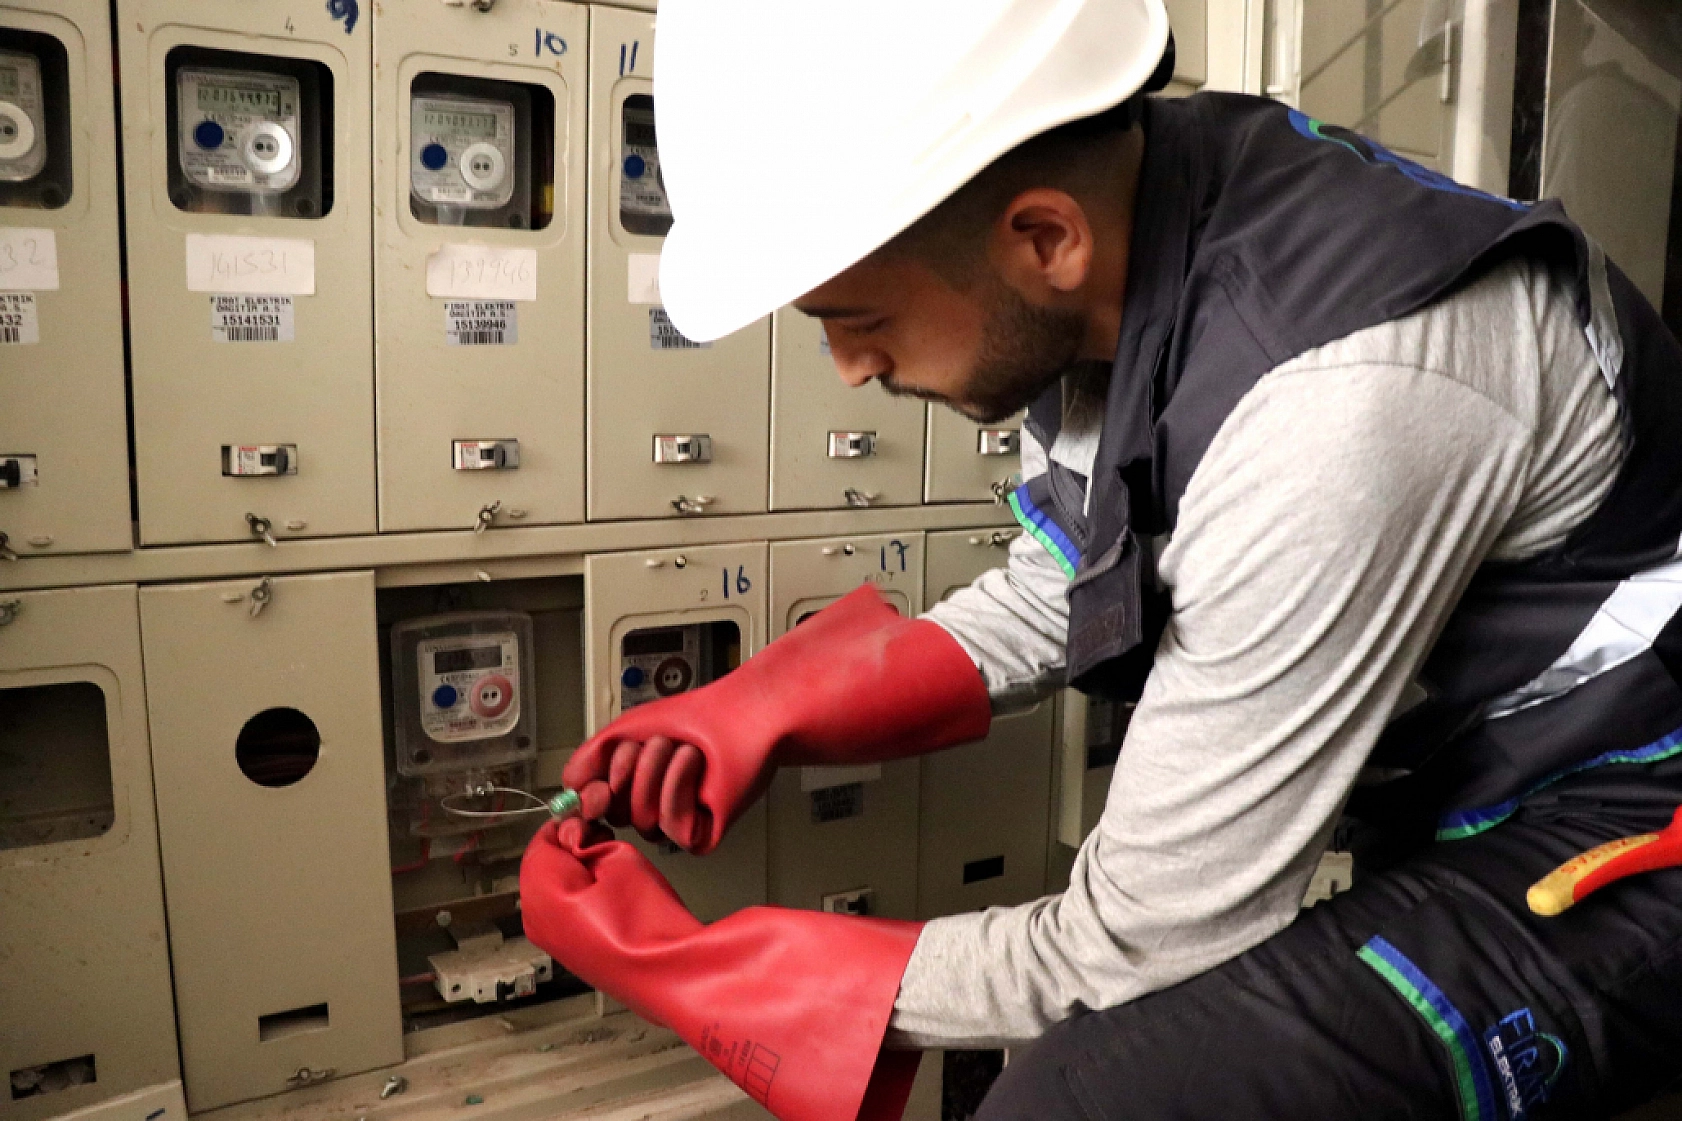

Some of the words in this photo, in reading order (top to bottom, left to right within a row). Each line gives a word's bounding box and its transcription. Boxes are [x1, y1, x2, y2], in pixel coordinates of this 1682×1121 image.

[327, 0, 360, 34] 9
[535, 28, 567, 57] 10
[620, 40, 639, 76] 11
[879, 538, 910, 572] 17
[723, 564, 752, 600] 16
